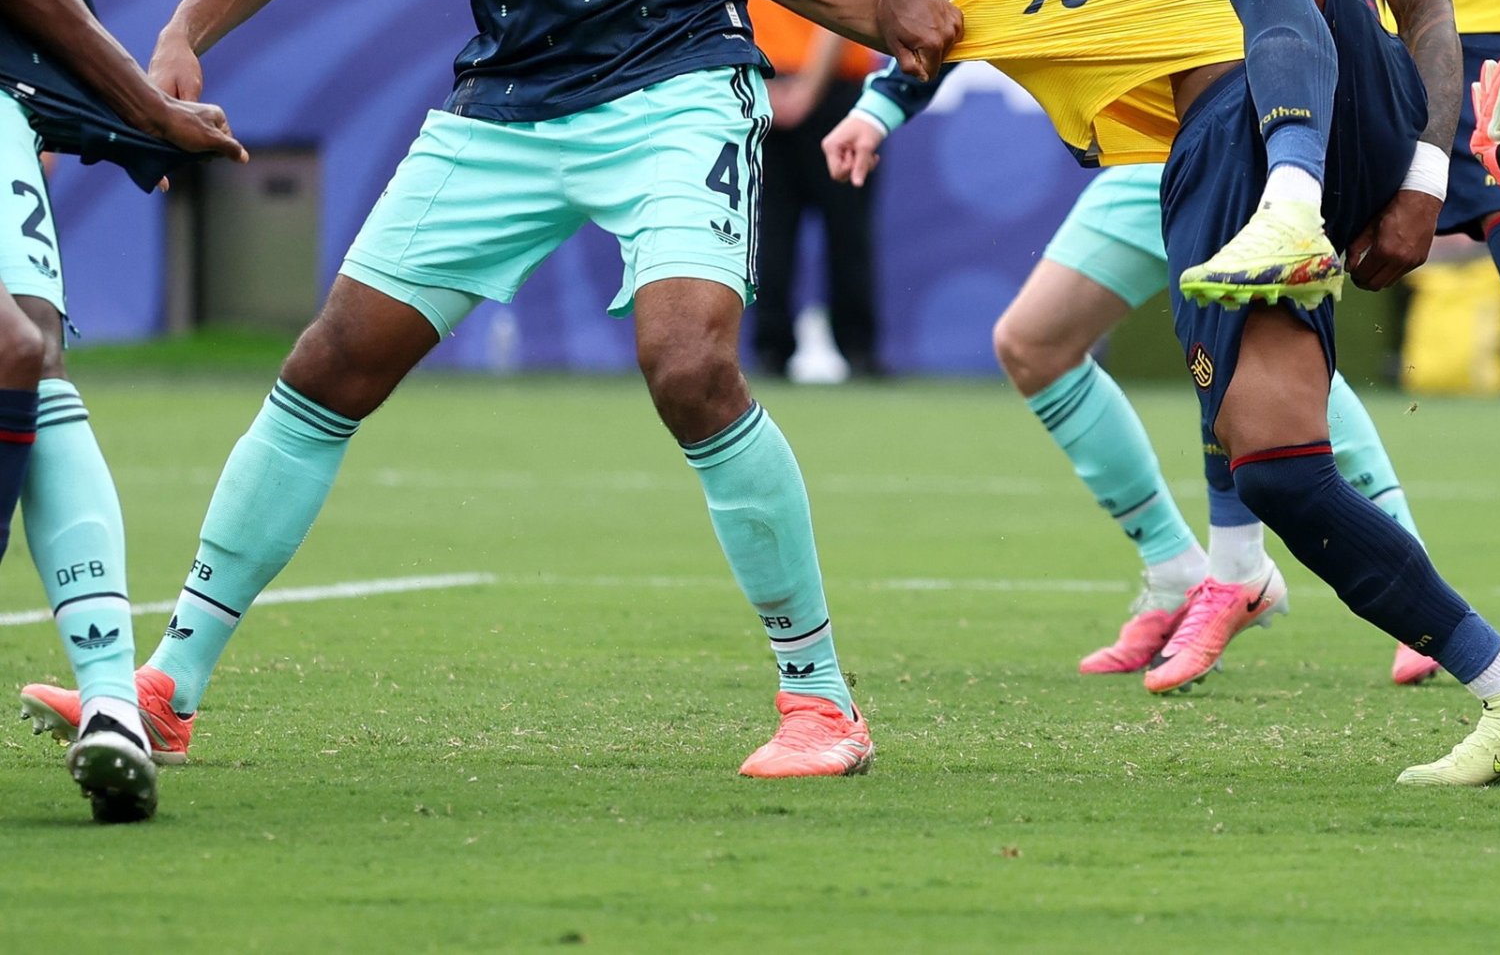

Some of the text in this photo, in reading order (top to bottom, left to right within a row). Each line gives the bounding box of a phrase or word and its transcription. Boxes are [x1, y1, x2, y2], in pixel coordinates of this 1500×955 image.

[1260, 106, 1311, 132] athon
[704, 142, 743, 212] 4
[12, 179, 53, 250] 2
[56, 560, 105, 587] DFB
